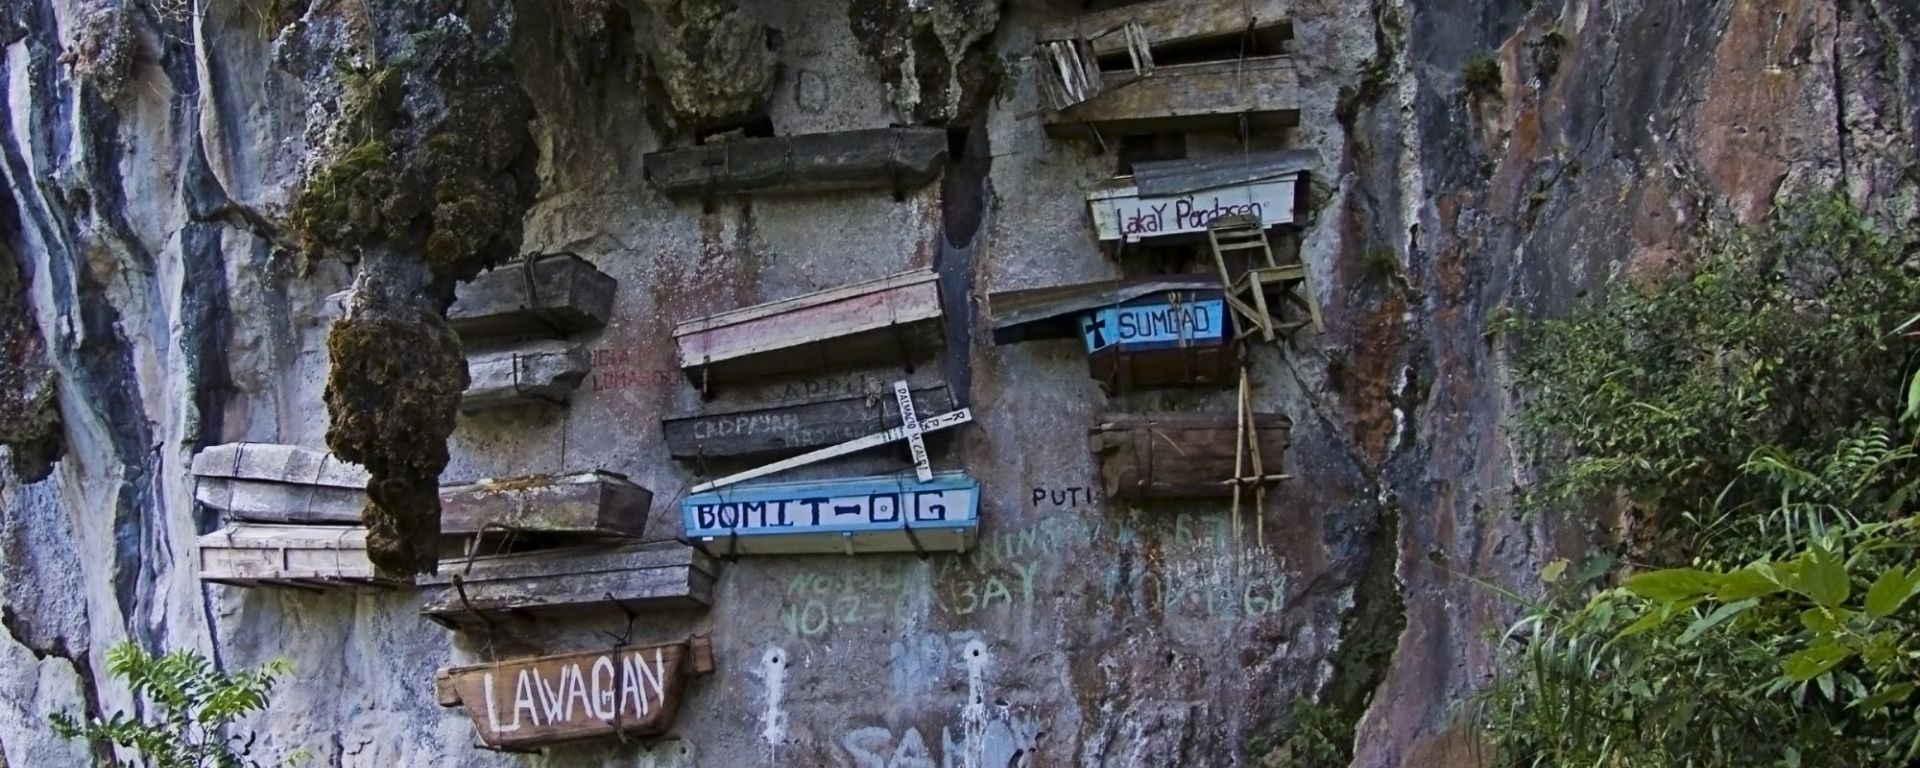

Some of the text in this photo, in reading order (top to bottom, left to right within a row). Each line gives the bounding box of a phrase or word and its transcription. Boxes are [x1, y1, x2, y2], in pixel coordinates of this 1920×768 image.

[898, 388, 917, 429] DALMACIO
[697, 490, 946, 529] BOMIT-OG
[1033, 487, 1091, 507] PUTI
[484, 648, 665, 732] LAWAGAN
